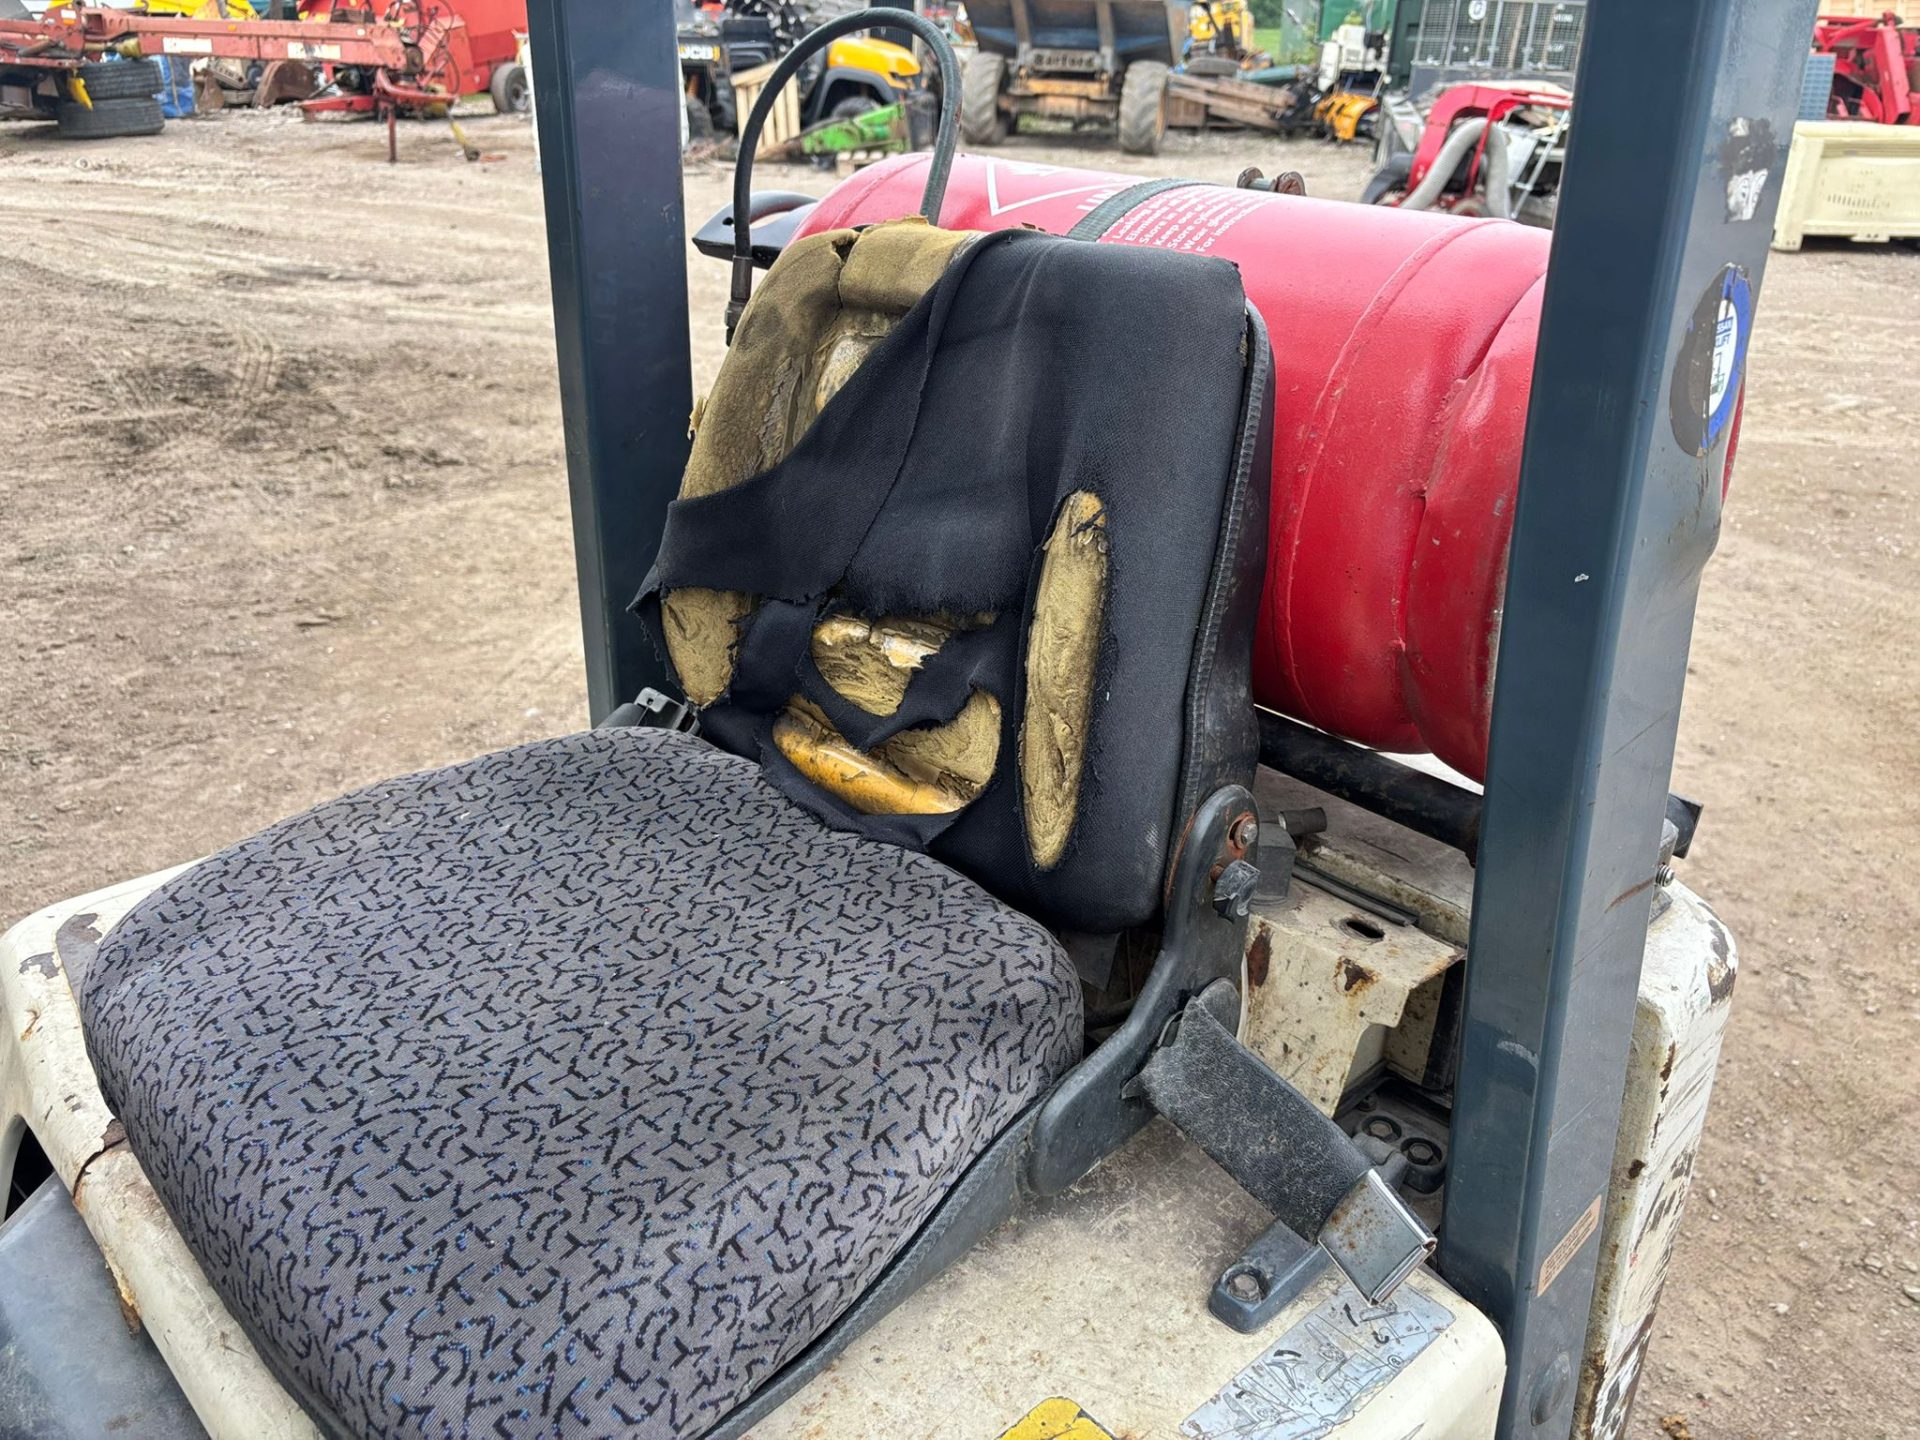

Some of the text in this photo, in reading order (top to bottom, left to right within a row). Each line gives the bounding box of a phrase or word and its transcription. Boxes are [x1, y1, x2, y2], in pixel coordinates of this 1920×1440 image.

[678, 44, 713, 60] JCB
[1167, 225, 1195, 249] Store
[1180, 227, 1208, 250] Wear
[1195, 237, 1215, 252] For
